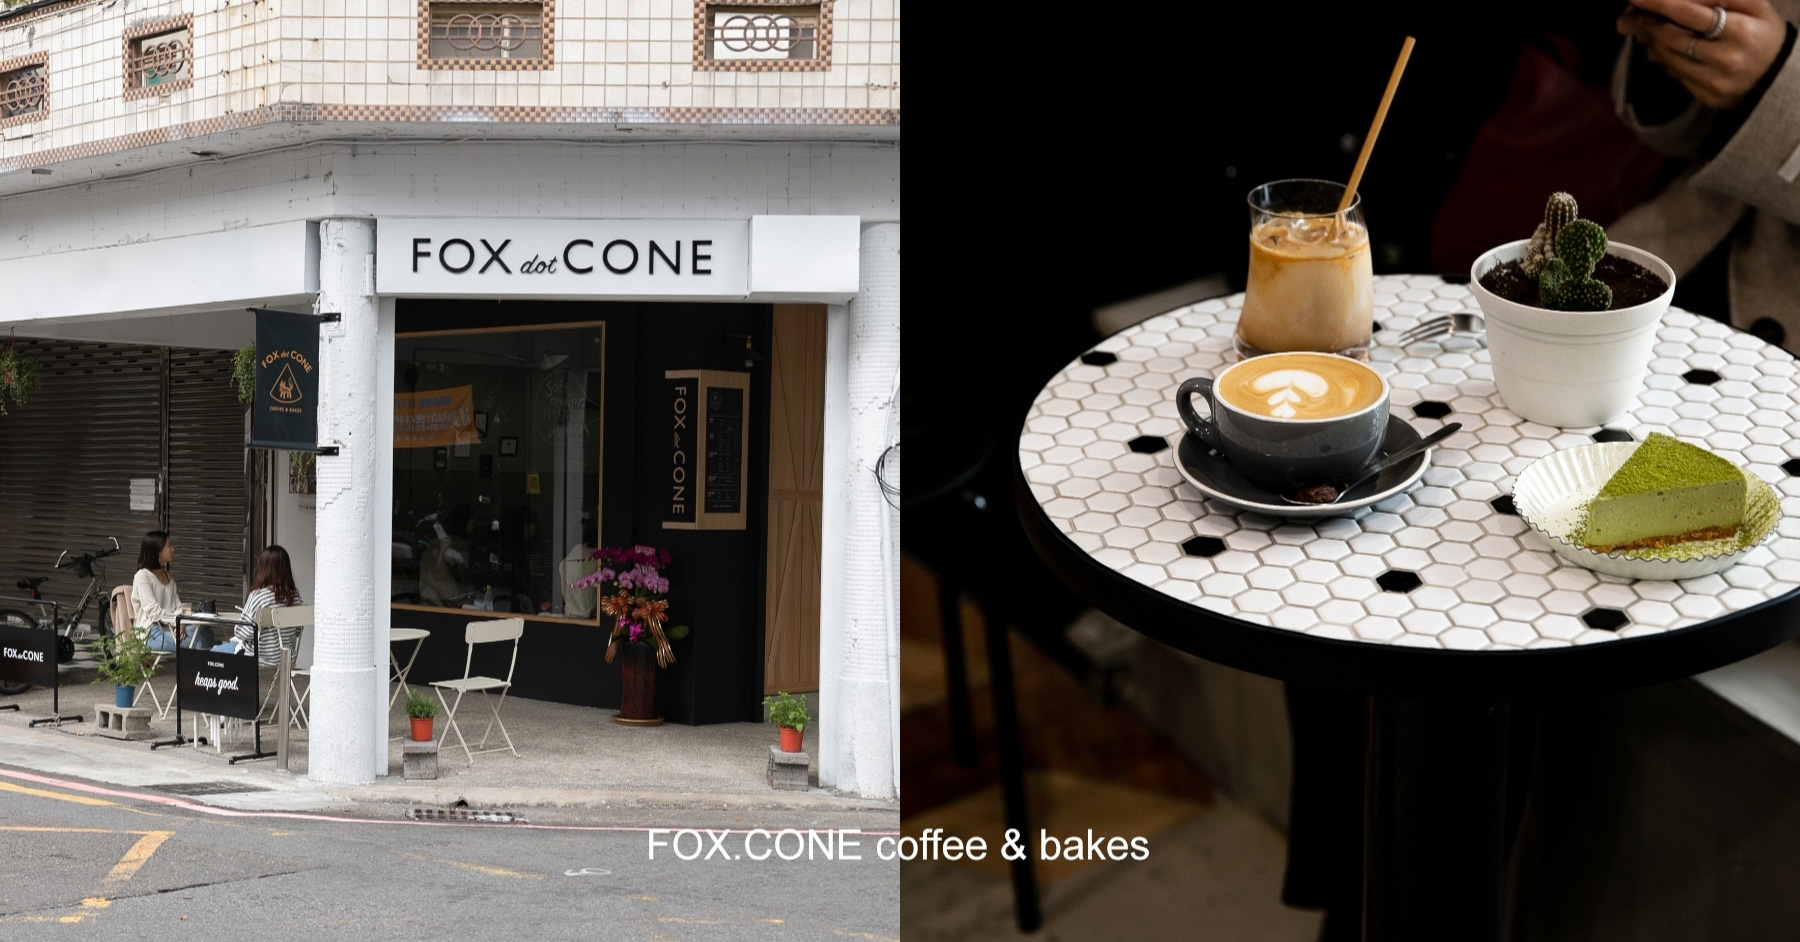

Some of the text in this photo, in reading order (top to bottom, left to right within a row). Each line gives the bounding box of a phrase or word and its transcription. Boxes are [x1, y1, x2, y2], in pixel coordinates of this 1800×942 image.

[412, 238, 713, 275] FOX dot CONE
[261, 350, 280, 369] FOX
[290, 350, 313, 374] CONE
[674, 386, 687, 429] FOX
[672, 450, 686, 514] CONE
[3, 647, 18, 659] FOX
[23, 649, 44, 662] CONE
[194, 671, 239, 696] heaps good.
